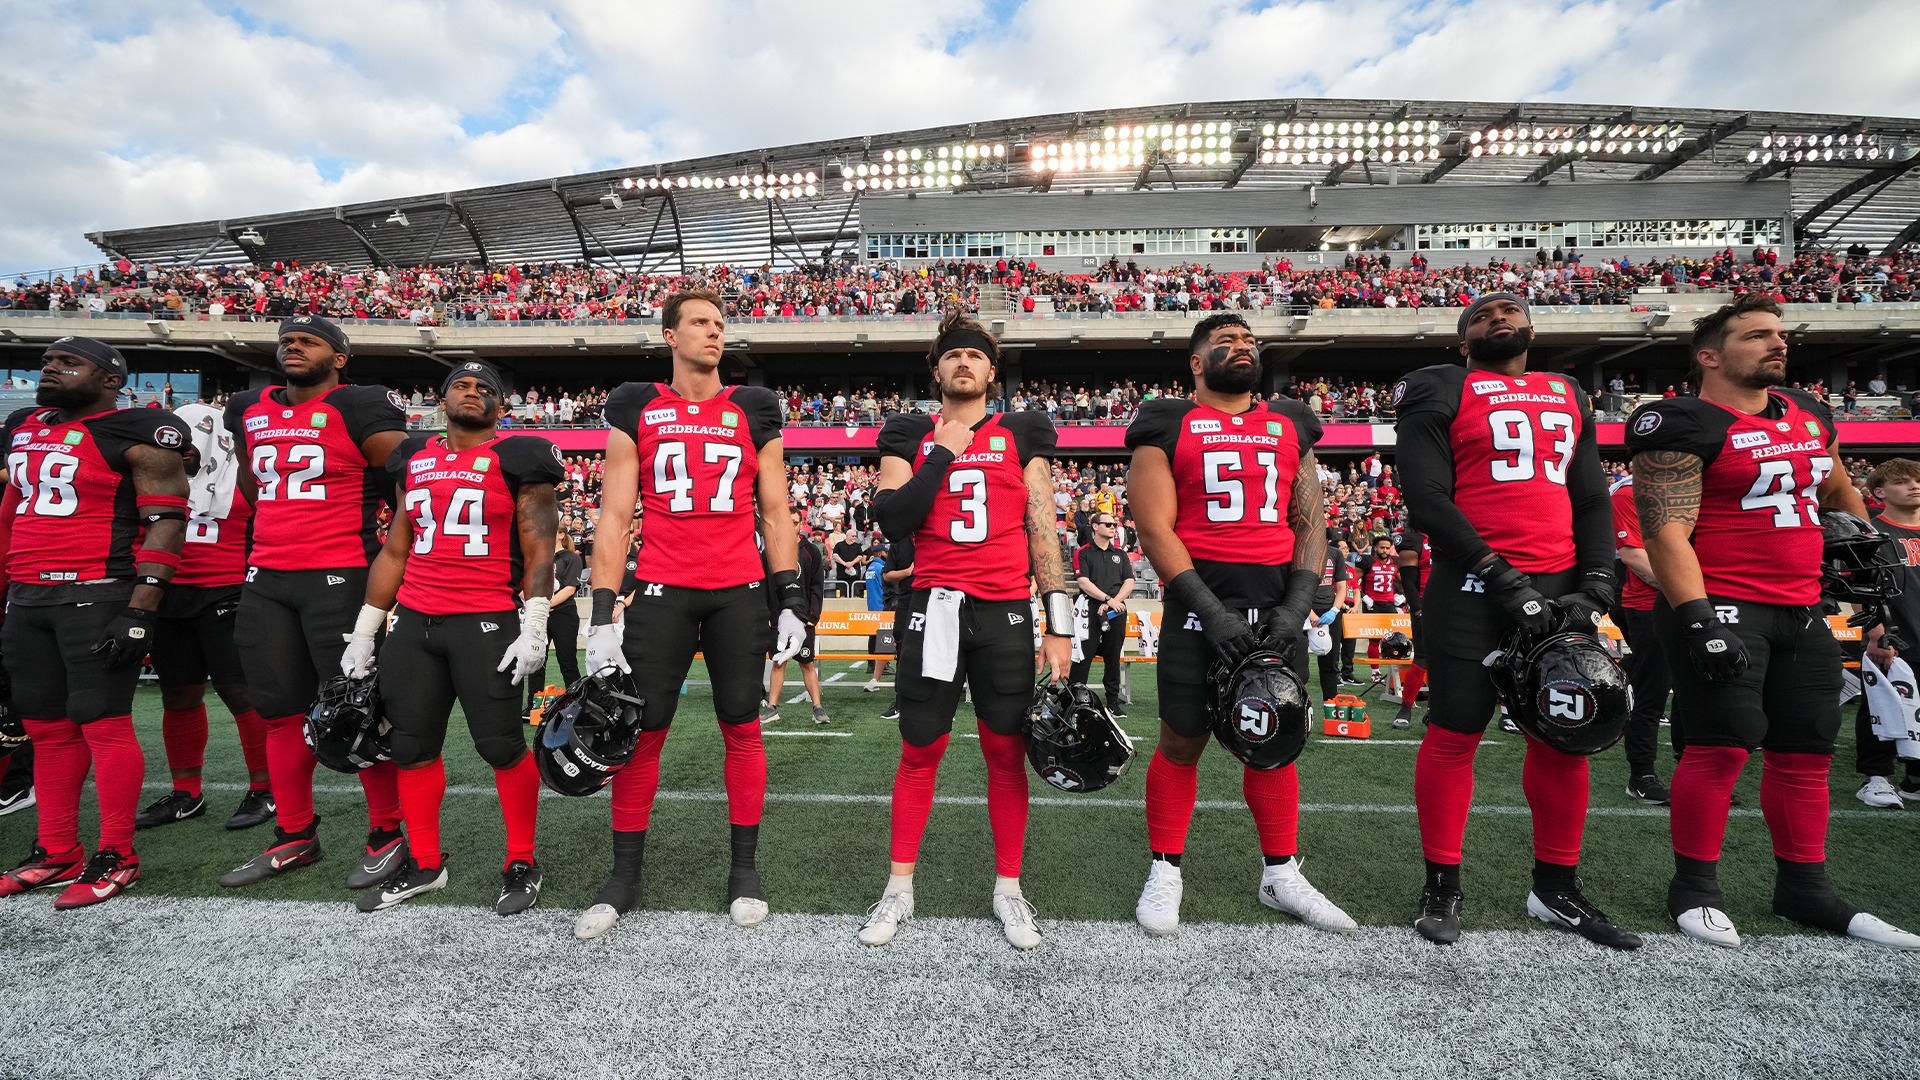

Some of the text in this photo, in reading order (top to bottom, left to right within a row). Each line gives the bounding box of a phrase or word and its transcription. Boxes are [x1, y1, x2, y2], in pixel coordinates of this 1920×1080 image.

[1307, 254, 1318, 262] SS
[1474, 382, 1506, 391] TELUS
[1488, 393, 1567, 405] REDBLACKS
[646, 411, 676, 421] TELUS
[1192, 422, 1221, 430] TELUS
[1639, 415, 1658, 430] R
[254, 428, 321, 441] REDBLACKS
[657, 424, 736, 438] REDBLACKS
[1202, 434, 1279, 446] REDBLACKS
[1733, 434, 1768, 446] TELUS
[1487, 409, 1576, 486] 93
[951, 452, 1004, 463] BLACKS
[411, 460, 436, 471] TELUS
[252, 444, 327, 501] 92
[414, 470, 486, 484] REDBLACKS
[653, 441, 743, 513] 47
[1202, 450, 1279, 524] 51
[1740, 456, 1835, 528] 45
[949, 467, 989, 544] 3
[404, 487, 490, 557] 34
[1525, 603, 1537, 613] CFL
[848, 612, 881, 621] LiUNA!
[908, 611, 926, 632] R
[817, 621, 850, 630] LiUNA!
[1708, 641, 1724, 650] CFL
[1549, 687, 1585, 721] R
[1239, 703, 1270, 736] R
[1337, 723, 1349, 735] G
